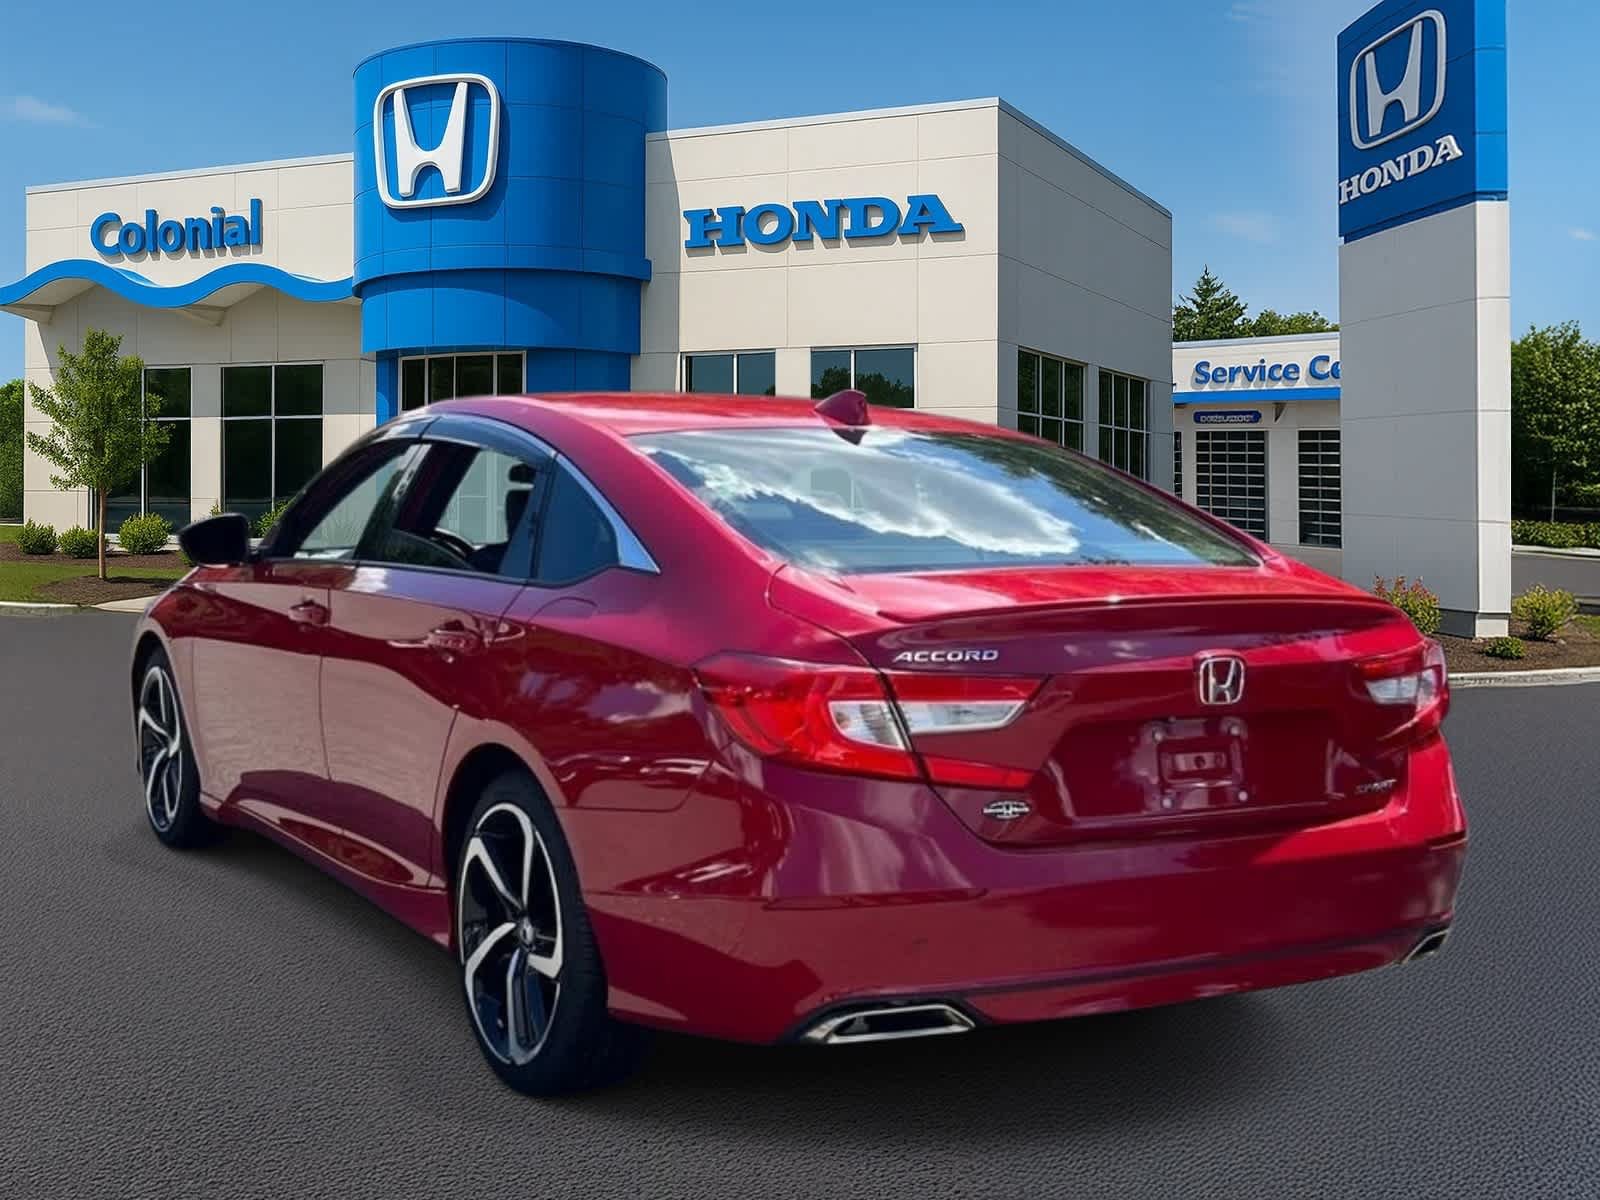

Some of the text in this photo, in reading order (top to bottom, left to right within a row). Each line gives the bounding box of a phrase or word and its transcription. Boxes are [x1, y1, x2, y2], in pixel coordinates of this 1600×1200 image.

[1338, 134, 1463, 205] HONDA
[90, 198, 263, 257] Colonial
[682, 194, 965, 249] HONDA
[1194, 358, 1300, 384] Service
[892, 649, 999, 662] ACCORD
